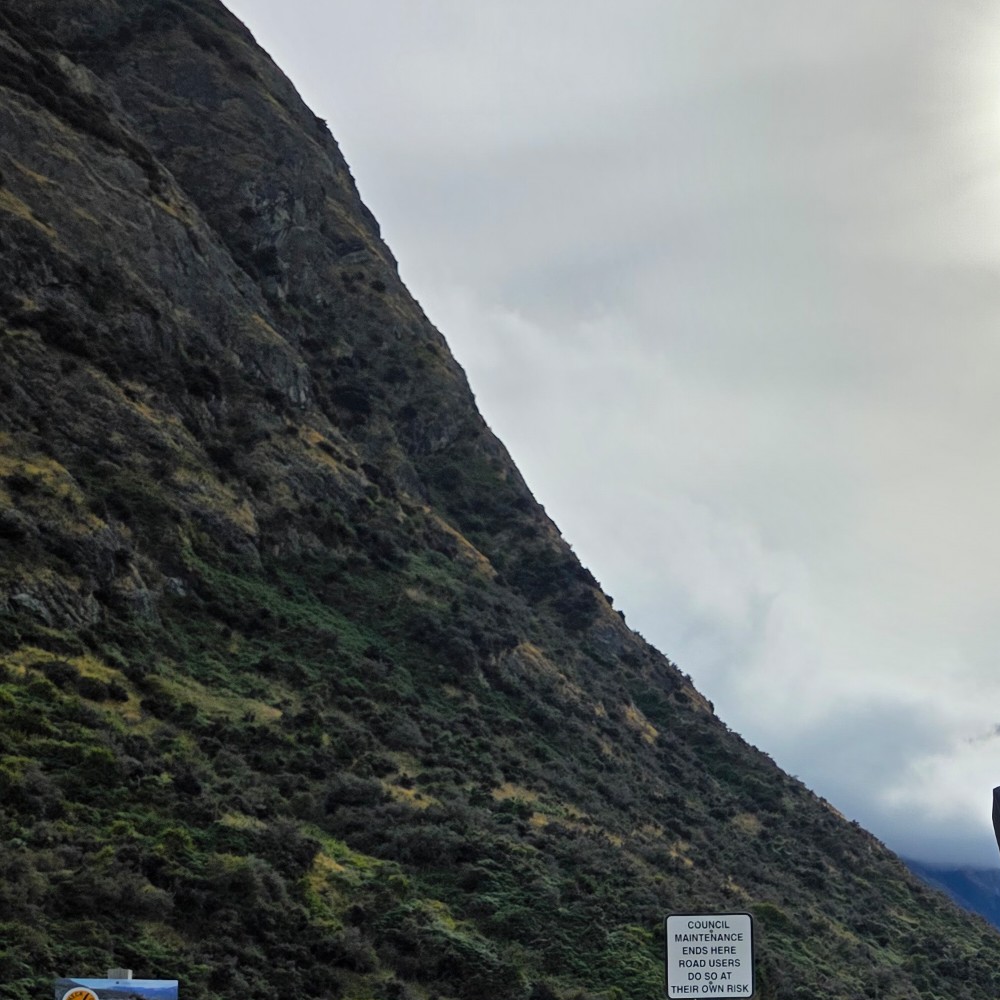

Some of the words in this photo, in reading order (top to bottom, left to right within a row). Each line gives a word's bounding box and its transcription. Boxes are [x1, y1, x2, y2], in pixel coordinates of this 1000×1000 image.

[688, 921, 730, 929] COUNCIL
[674, 933, 744, 942] MAINTENANCE
[682, 946, 708, 955] ENDS
[711, 946, 736, 954] HERE
[679, 959, 706, 968] ROAD
[709, 959, 741, 967] USERS
[688, 972, 701, 980] DO
[704, 972, 718, 980] SO
[720, 972, 732, 980] AT
[671, 985, 699, 993] THEIR
[701, 985, 724, 993] OWN
[727, 984, 749, 993] RISK
